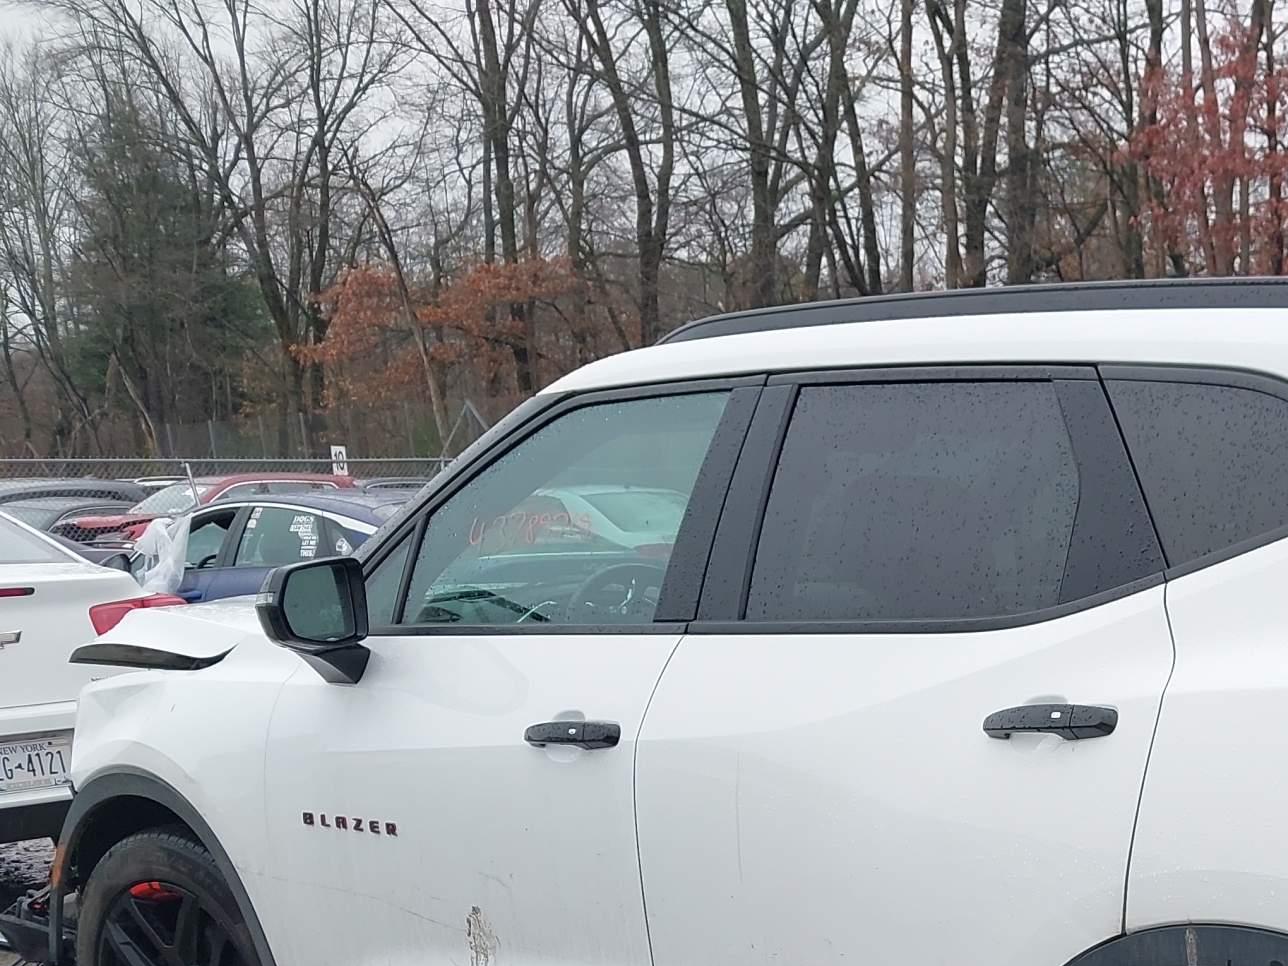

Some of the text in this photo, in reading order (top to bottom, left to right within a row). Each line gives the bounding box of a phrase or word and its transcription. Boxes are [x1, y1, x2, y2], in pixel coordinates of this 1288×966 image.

[20, 742, 47, 754] YORK
[27, 750, 66, 777] 4121
[302, 811, 398, 837] BLAZER
